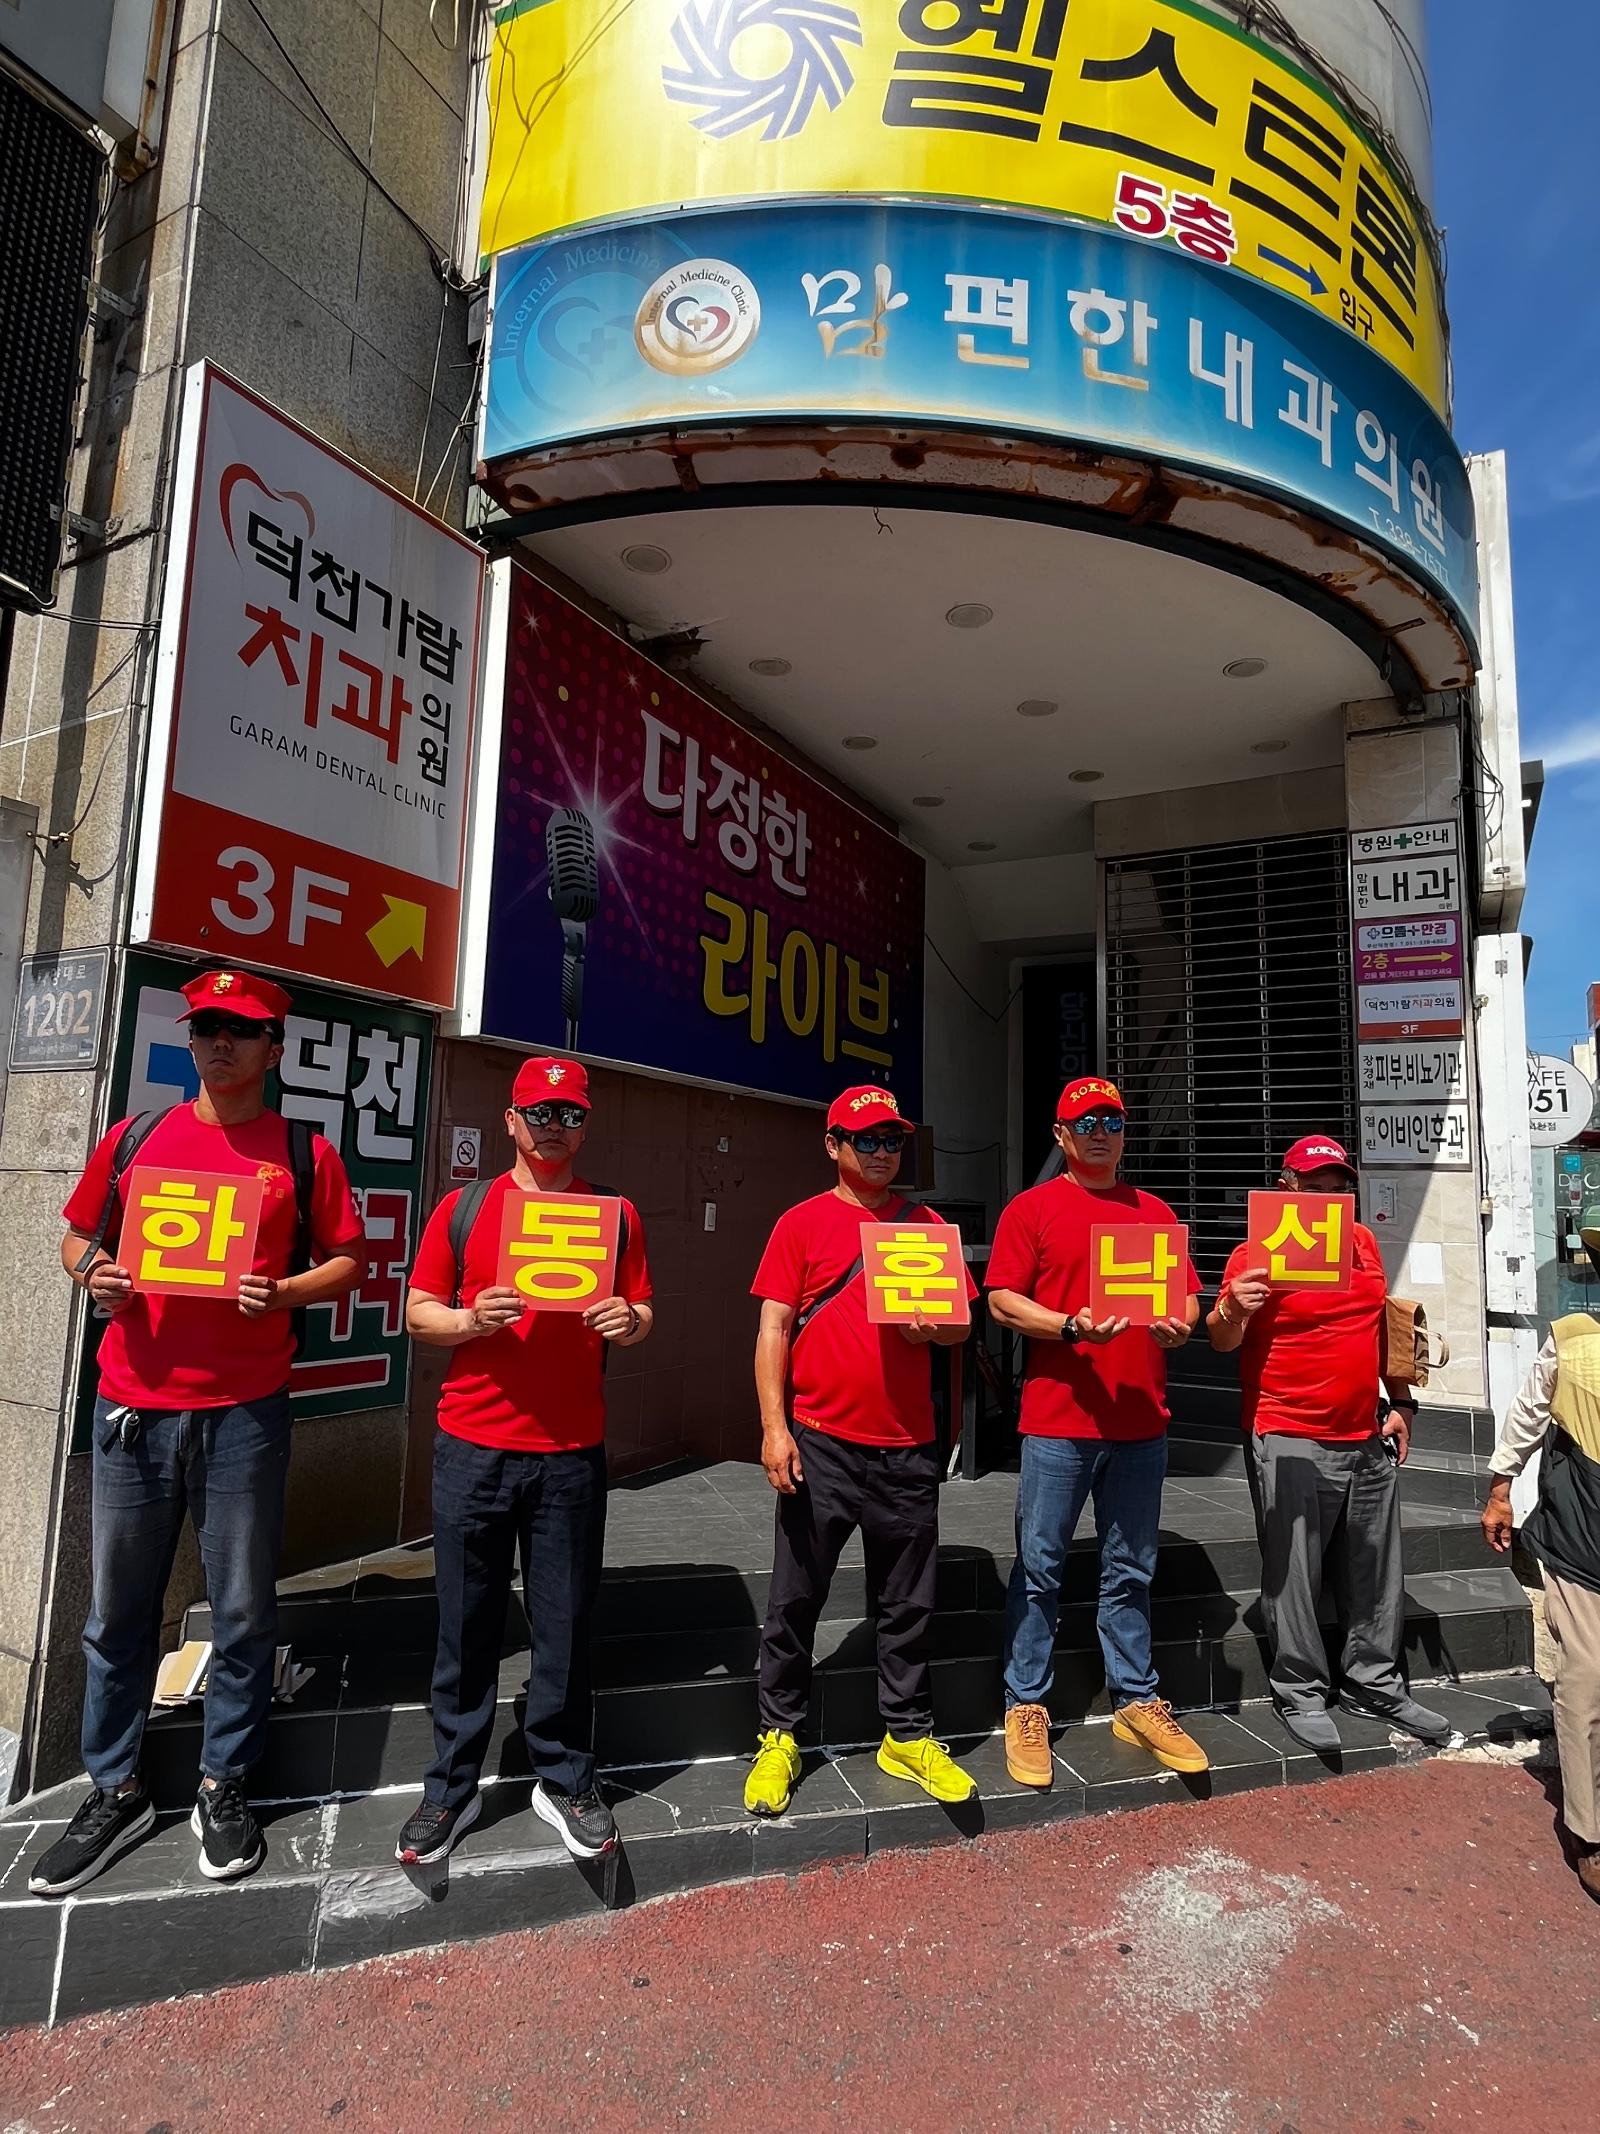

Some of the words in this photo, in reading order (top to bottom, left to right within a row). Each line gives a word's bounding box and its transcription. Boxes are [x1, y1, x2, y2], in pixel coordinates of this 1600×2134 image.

[1116, 174, 1236, 264] 5층
[500, 266, 558, 350] Internal
[563, 239, 660, 272] Medicine
[645, 280, 677, 325] Internal
[680, 269, 730, 286] Medicine
[731, 285, 748, 316] Clinic
[1339, 287, 1375, 341] 입구
[247, 510, 462, 685] 덕천가람
[238, 602, 412, 765] 치과
[417, 693, 451, 788] 의원
[230, 715, 309, 763] GARAM
[316, 750, 388, 796] DENTAL
[394, 783, 447, 820] CLINIC
[640, 709, 813, 897] 다정한
[1358, 835, 1392, 853] 병원
[1413, 828, 1449, 846] 안내
[211, 846, 350, 947] 3F
[1373, 867, 1456, 903] 내과
[700, 891, 893, 1067] 라이브
[1362, 952, 1389, 970] 2층
[24, 989, 93, 1038] 1202
[1401, 1024, 1420, 1035] 3F
[280, 1014, 421, 1161] 덕천
[1528, 1070, 1567, 1086] AFE
[1528, 1088, 1569, 1113] 51
[1378, 1113, 1465, 1154] 이비인후과
[140, 1181, 244, 1287] 한
[509, 1201, 608, 1300] 동
[873, 1232, 958, 1314] 훈
[1099, 1233, 1178, 1317] 낙
[1261, 1203, 1342, 1282] 선
